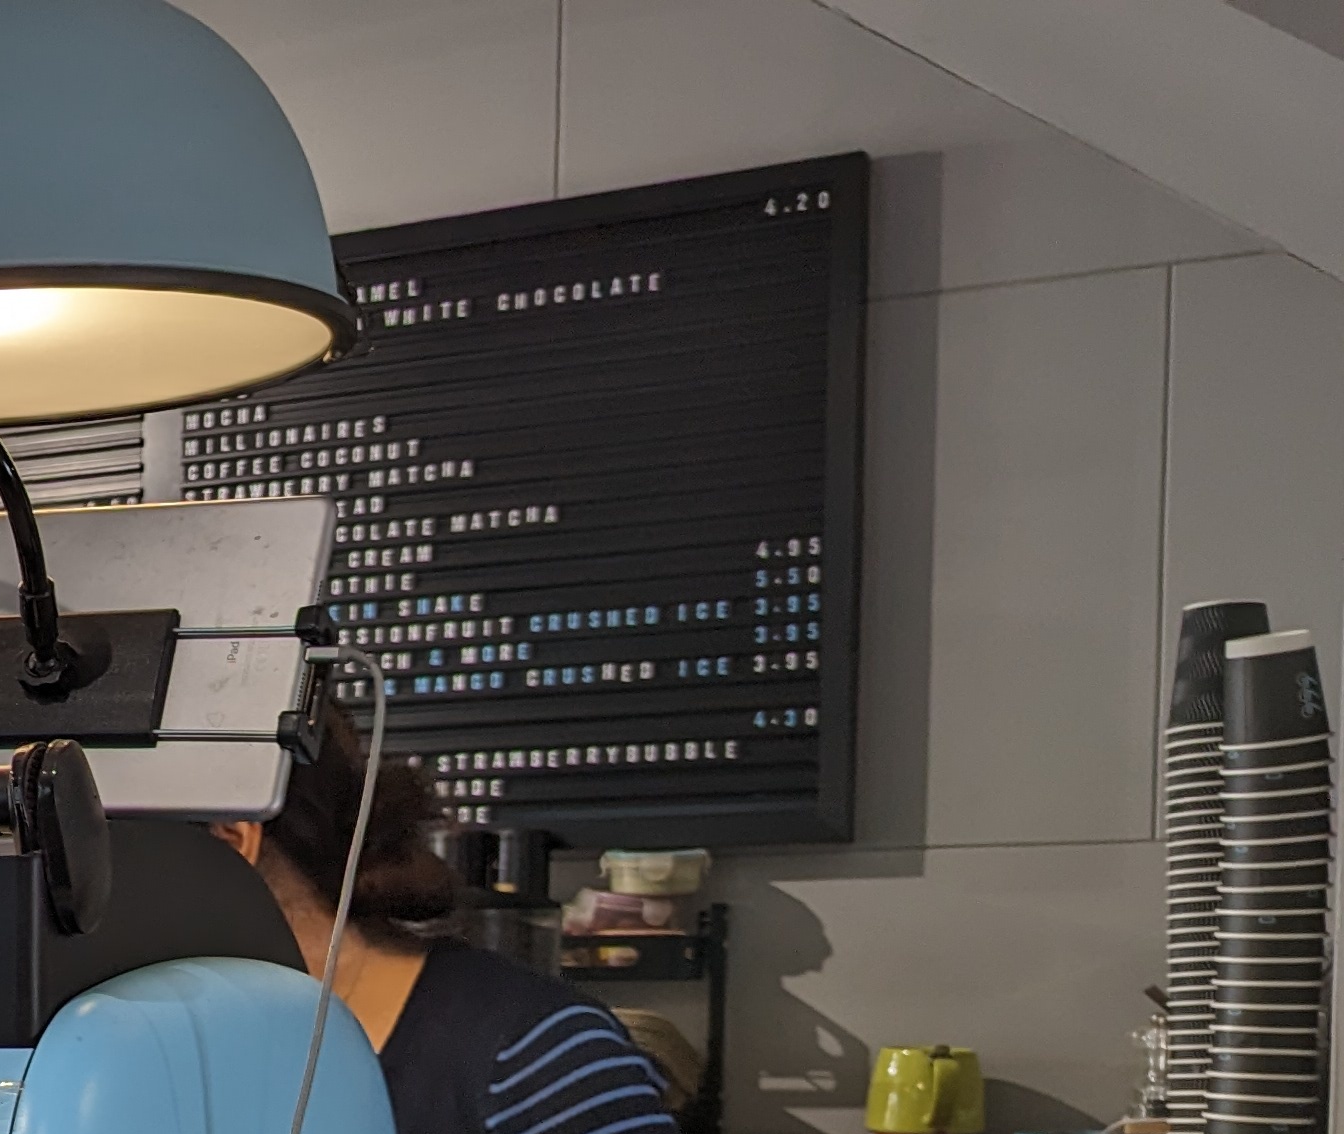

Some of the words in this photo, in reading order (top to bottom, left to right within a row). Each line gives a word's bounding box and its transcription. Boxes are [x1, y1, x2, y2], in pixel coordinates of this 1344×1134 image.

[764, 191, 830, 217] 4.20
[384, 300, 468, 327] WHITE
[497, 272, 662, 312] CHOCOLATE
[186, 404, 267, 431] MOCHA
[184, 415, 387, 458] MILLIONAIRES
[187, 454, 283, 481] COFFEE
[300, 438, 421, 469] COCONUT
[368, 459, 474, 489] MATCHA
[450, 505, 559, 534] MATCHA
[348, 544, 433, 569] CREAM
[398, 593, 484, 618] SHAKE
[529, 605, 661, 634] CRUSHED
[677, 599, 731, 624] ICE
[461, 642, 533, 665] MORE
[414, 670, 505, 695] MANGO
[525, 660, 656, 689] CRUSHED
[678, 656, 732, 679] ICE
